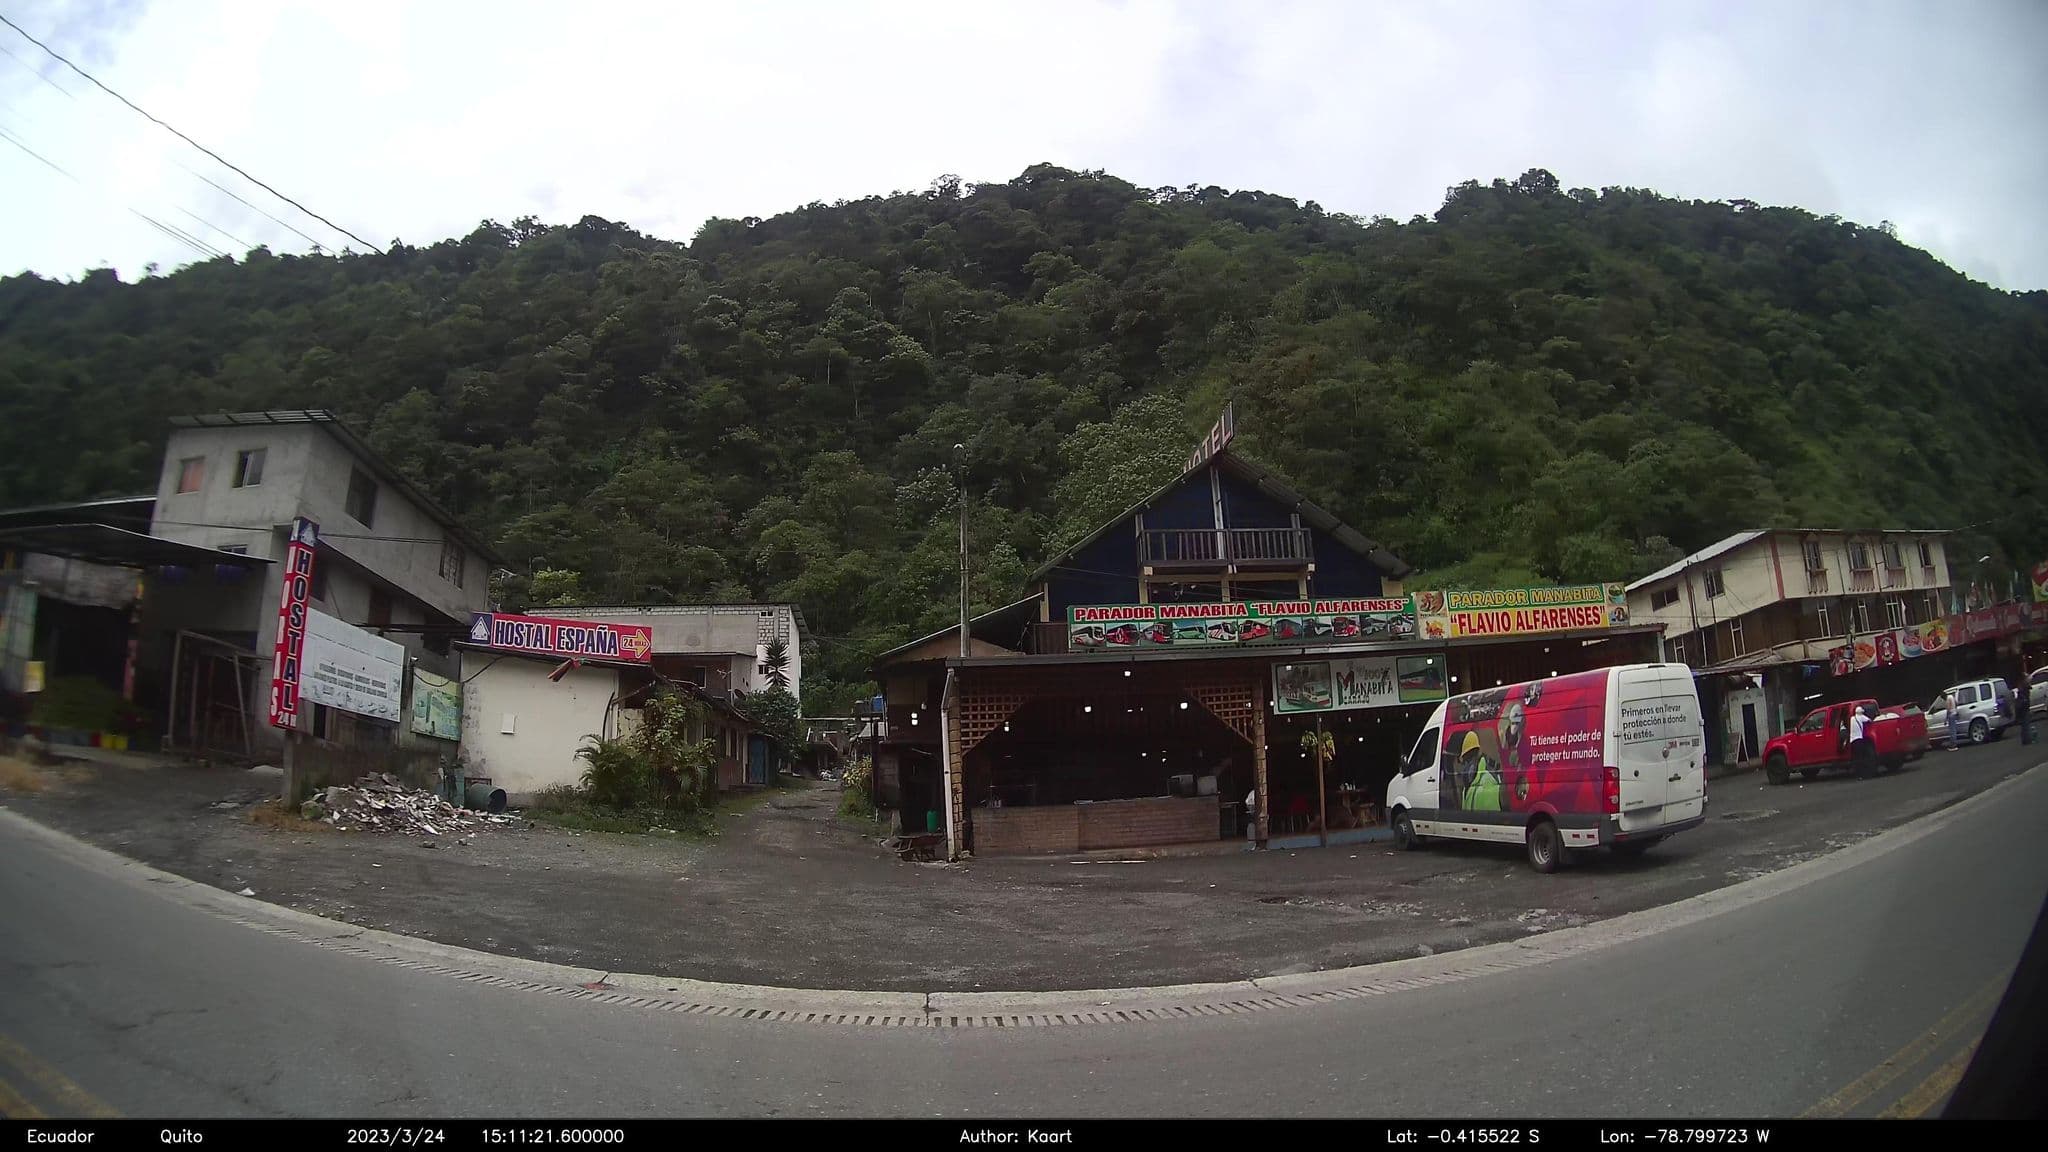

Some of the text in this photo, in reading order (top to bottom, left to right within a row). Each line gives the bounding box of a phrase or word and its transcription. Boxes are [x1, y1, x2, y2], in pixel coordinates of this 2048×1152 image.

[1450, 586, 1602, 608] PARADOR MANABITA
[1074, 606, 1156, 621] PARADOR
[1159, 602, 1248, 618] MANABITA
[282, 547, 312, 711] HOSTAL
[494, 619, 619, 656] HOSTAL ESPAÑA
[623, 638, 633, 648] 24
[1336, 671, 1394, 706] MANABITA
[277, 711, 297, 727] 24 H
[1622, 707, 1654, 717] Primeros
[1623, 715, 1661, 731] protección
[1667, 714, 1687, 724] donde
[1538, 734, 1559, 745] tienes
[1560, 732, 1567, 744] el
[1568, 730, 1590, 746] poder
[1591, 729, 1601, 740] de
[1531, 746, 1600, 764] proteger tu mundo.
